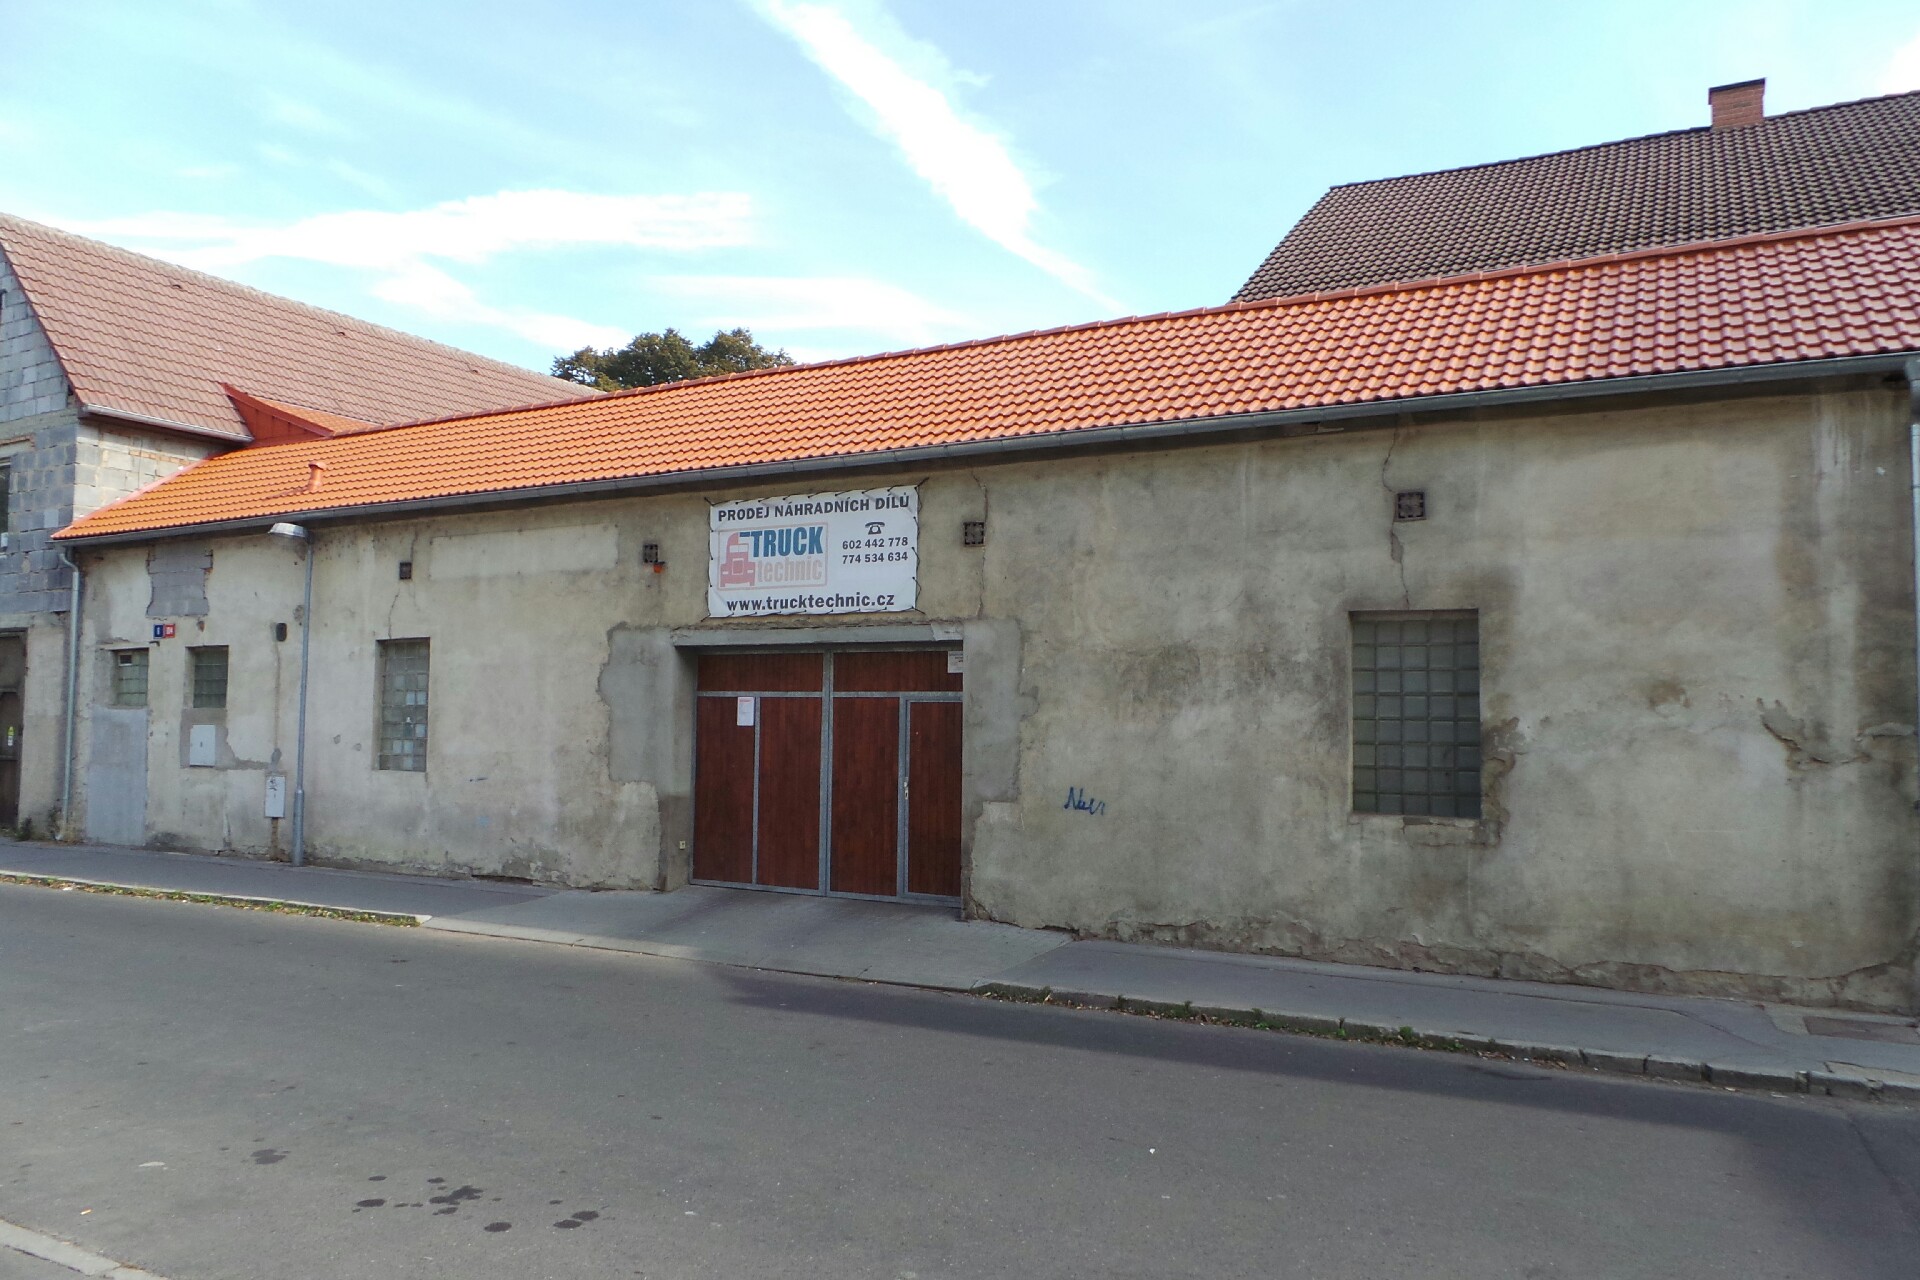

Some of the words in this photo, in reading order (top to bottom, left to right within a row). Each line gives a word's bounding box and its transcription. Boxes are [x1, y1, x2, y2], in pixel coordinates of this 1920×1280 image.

[718, 506, 770, 522] PRODEJ
[774, 496, 870, 518] NÁHRADNÍCH
[875, 491, 910, 510] DÍLŮ
[750, 526, 824, 558] TRUCK
[842, 540, 862, 550] 602
[864, 538, 885, 548] 442
[888, 536, 909, 547] 778
[842, 554, 861, 564] 774
[864, 552, 884, 563] 534
[887, 551, 908, 562] 634
[757, 556, 822, 583] technic
[726, 591, 895, 611] www.trucktechnic.cz
